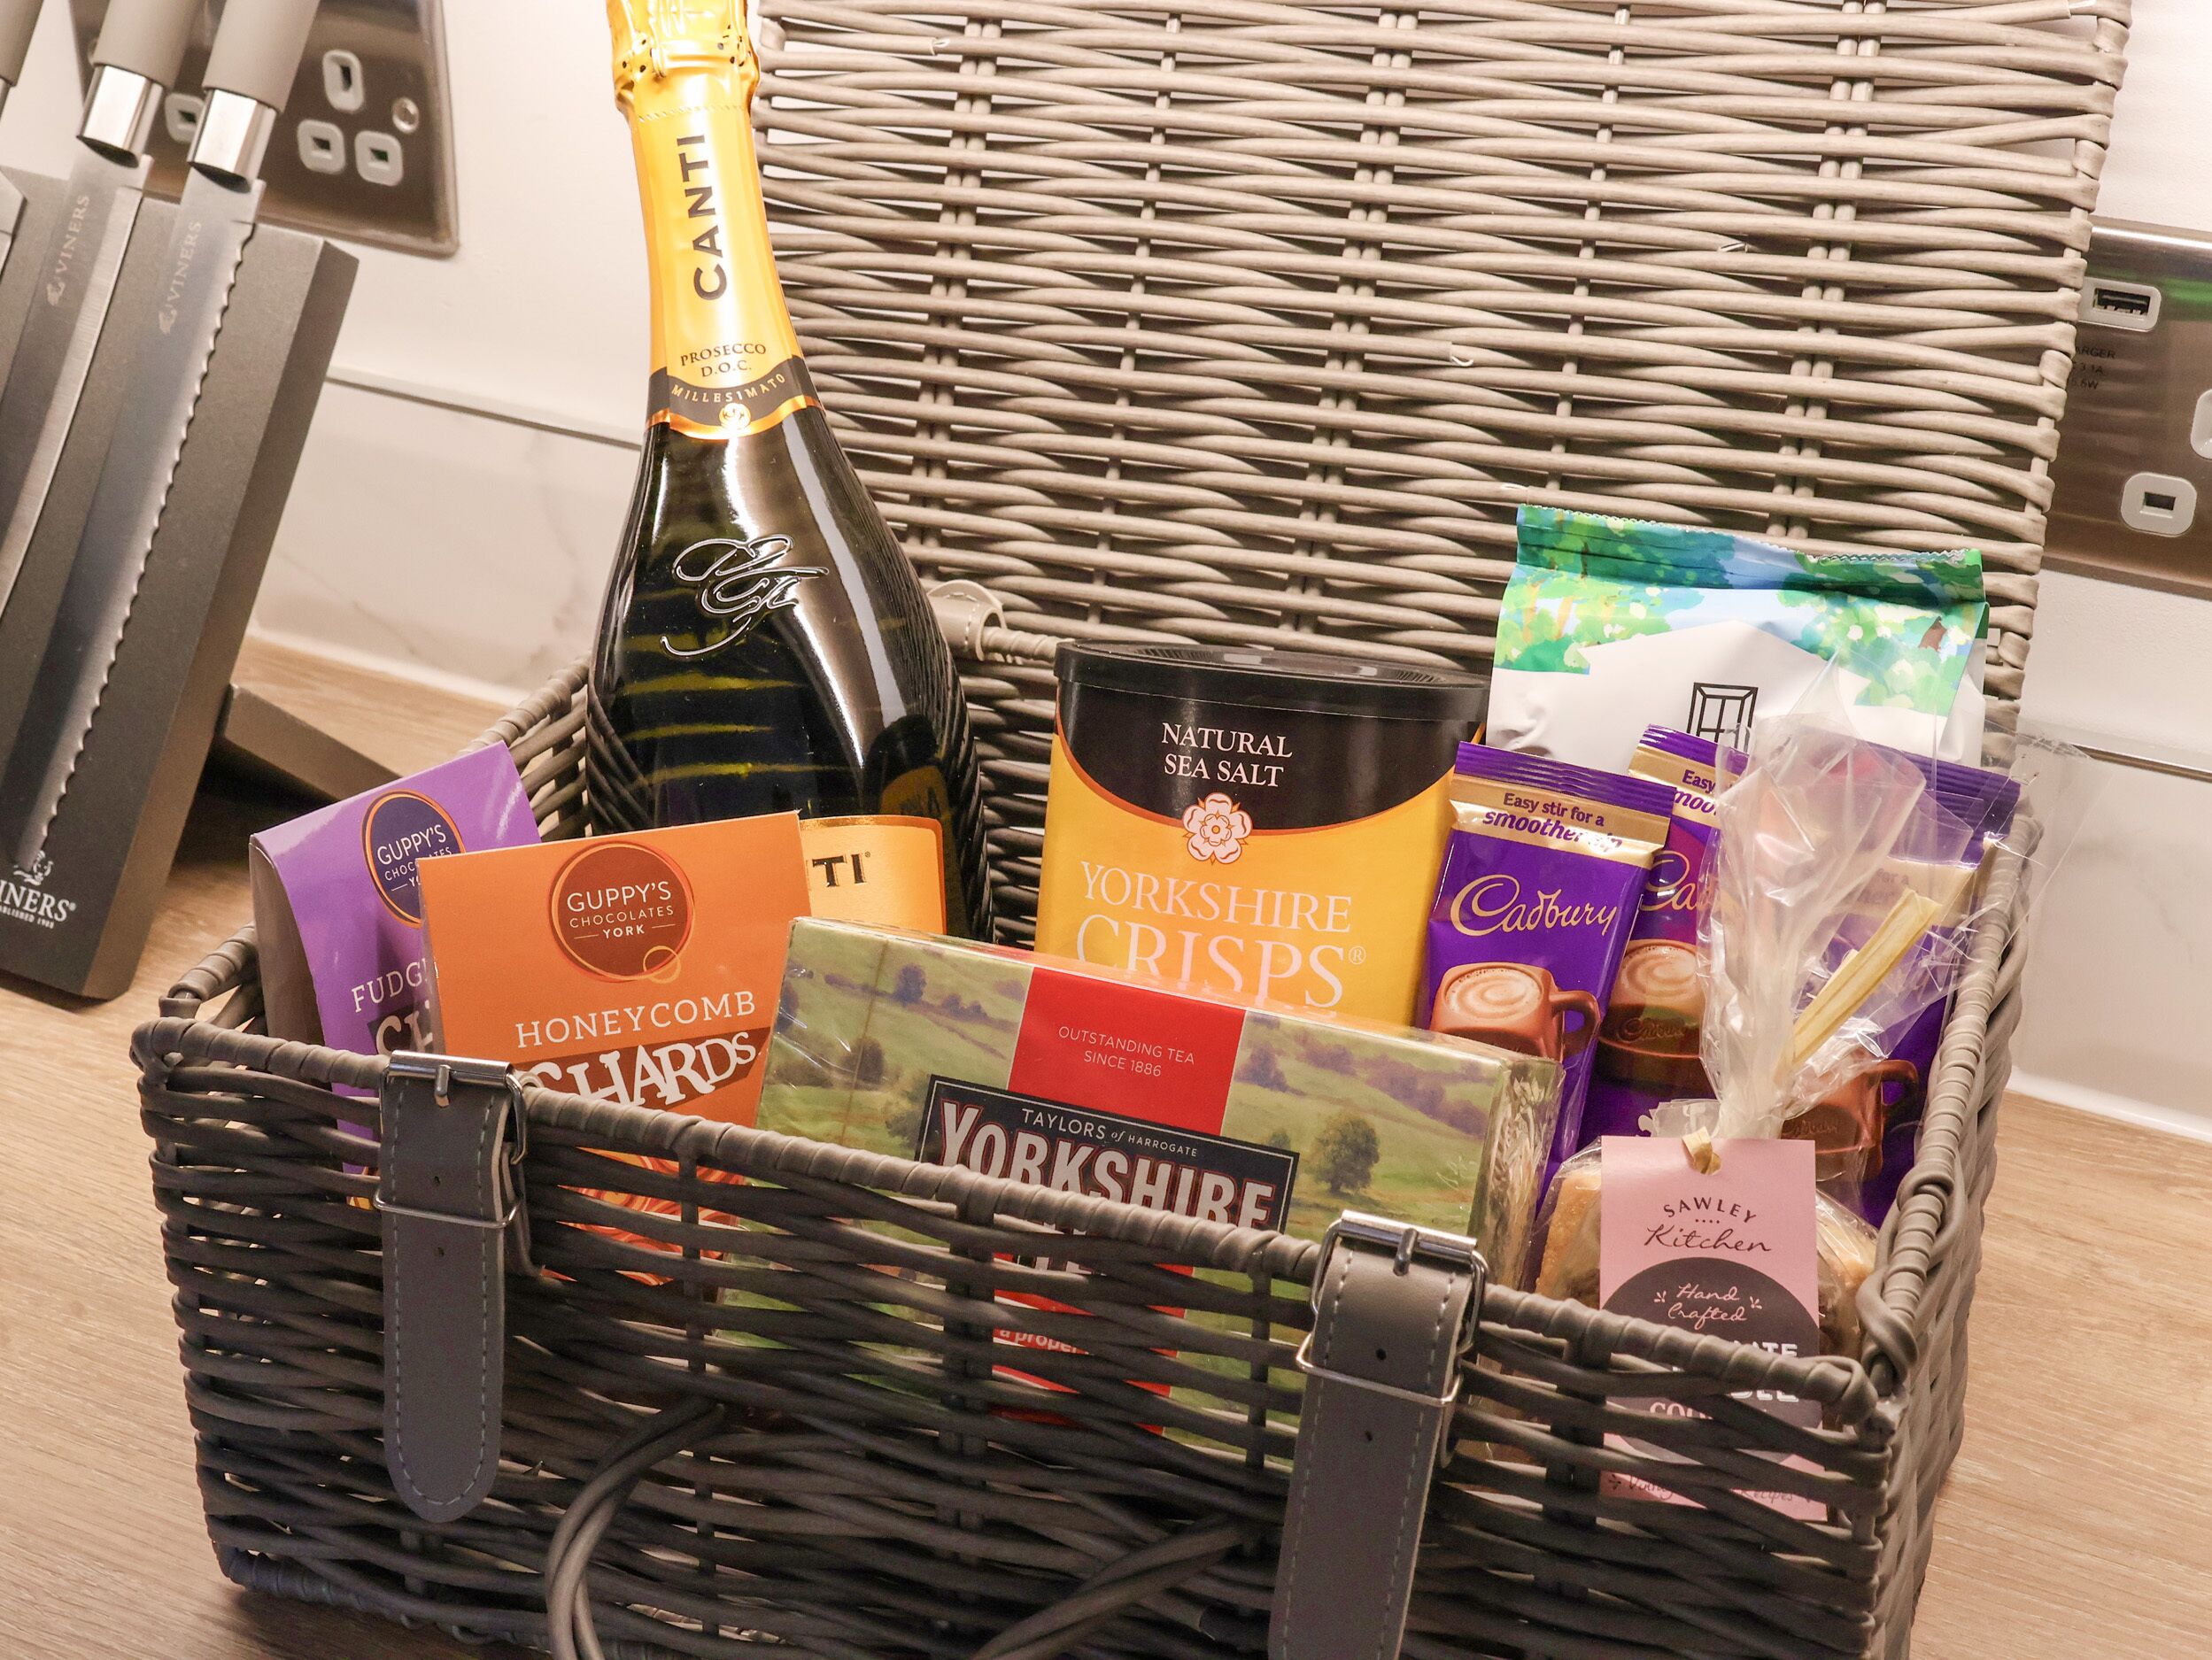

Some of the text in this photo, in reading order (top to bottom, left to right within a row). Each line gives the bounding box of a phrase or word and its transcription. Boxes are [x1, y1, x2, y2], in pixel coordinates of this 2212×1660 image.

[677, 134, 728, 301] CANTI
[55, 195, 90, 275] VINERS
[166, 220, 202, 303] VINERS
[680, 343, 767, 367] PROSECCO
[700, 359, 752, 378] D.O.C.
[2076, 346, 2115, 359] ARGER
[670, 373, 786, 403] MILLESIMATO
[1161, 722, 1293, 759] NATURAL
[1164, 753, 1285, 787] SEA SALT
[1682, 768, 1716, 795] Easy
[1503, 792, 1605, 827] Easy stir for a
[376, 823, 447, 866] GUPPY'S
[0, 879, 70, 923] INERS
[566, 880, 672, 913] GUPPY'S
[1081, 861, 1353, 933] YORKSHIRE
[1450, 874, 1619, 938] Cadbury
[569, 905, 675, 929] CHOCOLATES
[602, 923, 645, 939] YORK
[515, 991, 756, 1049] HONEYCOMB
[1058, 1025, 1195, 1065] OUTSTANDING TEA
[1083, 1050, 1163, 1077] SINCE 1886
[1022, 1108, 1198, 1158] TAYLORS of HARROGATE
[940, 1098, 1278, 1231] YORKSHIRE
[1663, 1196, 1758, 1224] SAWLEY
[1644, 1224, 1773, 1253] Kitchen
[1675, 1282, 1741, 1301] Hand
[1667, 1301, 1748, 1331] Crafted
